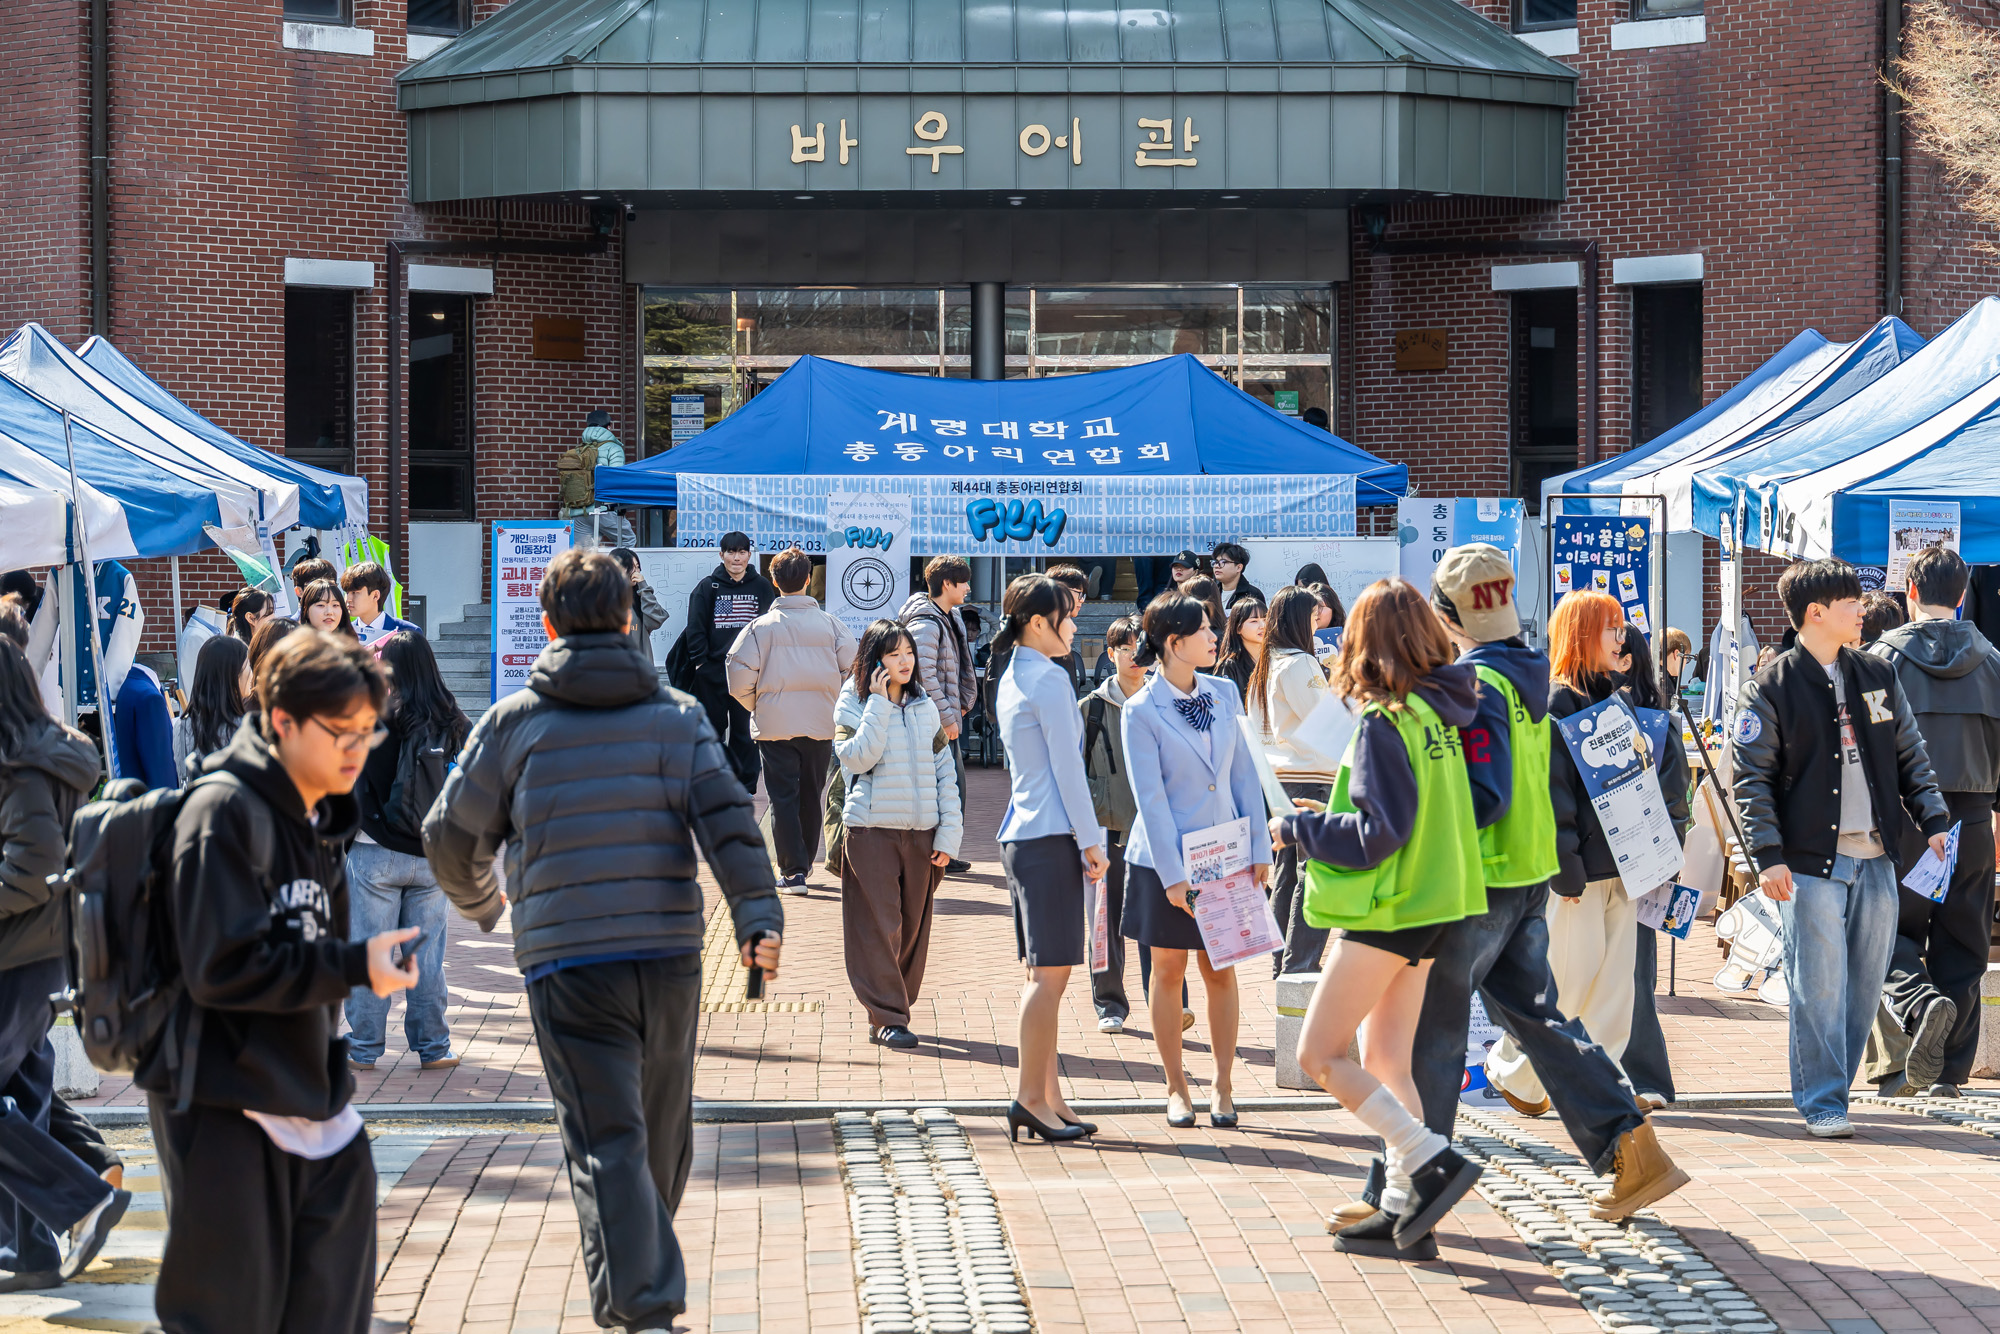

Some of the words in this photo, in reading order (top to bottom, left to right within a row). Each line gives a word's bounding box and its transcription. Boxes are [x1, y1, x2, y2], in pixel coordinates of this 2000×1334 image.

[790, 110, 1200, 173] 바우어관
[877, 409, 1120, 440] 계명대학교
[843, 441, 1170, 465] 총동아리연합회
[755, 477, 839, 496] WELCOME
[843, 478, 928, 496] WELCOME
[1105, 478, 1189, 496] WELCOME
[1192, 478, 1276, 496] WELCOME
[951, 481, 993, 494] 제44대
[995, 481, 1082, 495] 총동아리연합회
[756, 496, 828, 515] WELCOM
[1105, 497, 1189, 516] WELCOME
[1192, 497, 1276, 516] WELCOME
[756, 515, 828, 534] WELCOM
[1105, 516, 1189, 535] WELCOME
[1192, 516, 1276, 535] WELCOME
[966, 498, 1067, 548] FILM
[510, 533, 557, 544] 개인(공유)형
[845, 526, 893, 552] FILM
[1105, 536, 1189, 554] WELCOME
[1571, 532, 1595, 546] 내가
[1599, 529, 1625, 548] 꿈을
[515, 545, 552, 555] 이동장치
[1566, 550, 1601, 566] 이루어
[501, 567, 527, 580] 교내
[1857, 568, 1884, 580] AGUNI
[507, 583, 532, 597] 통행
[1471, 578, 1510, 610] NY
[97, 596, 111, 620] K
[117, 597, 136, 620] 21
[504, 670, 526, 678] 2026.
[1862, 689, 1894, 724] K
[1190, 850, 1208, 861] 제10기
